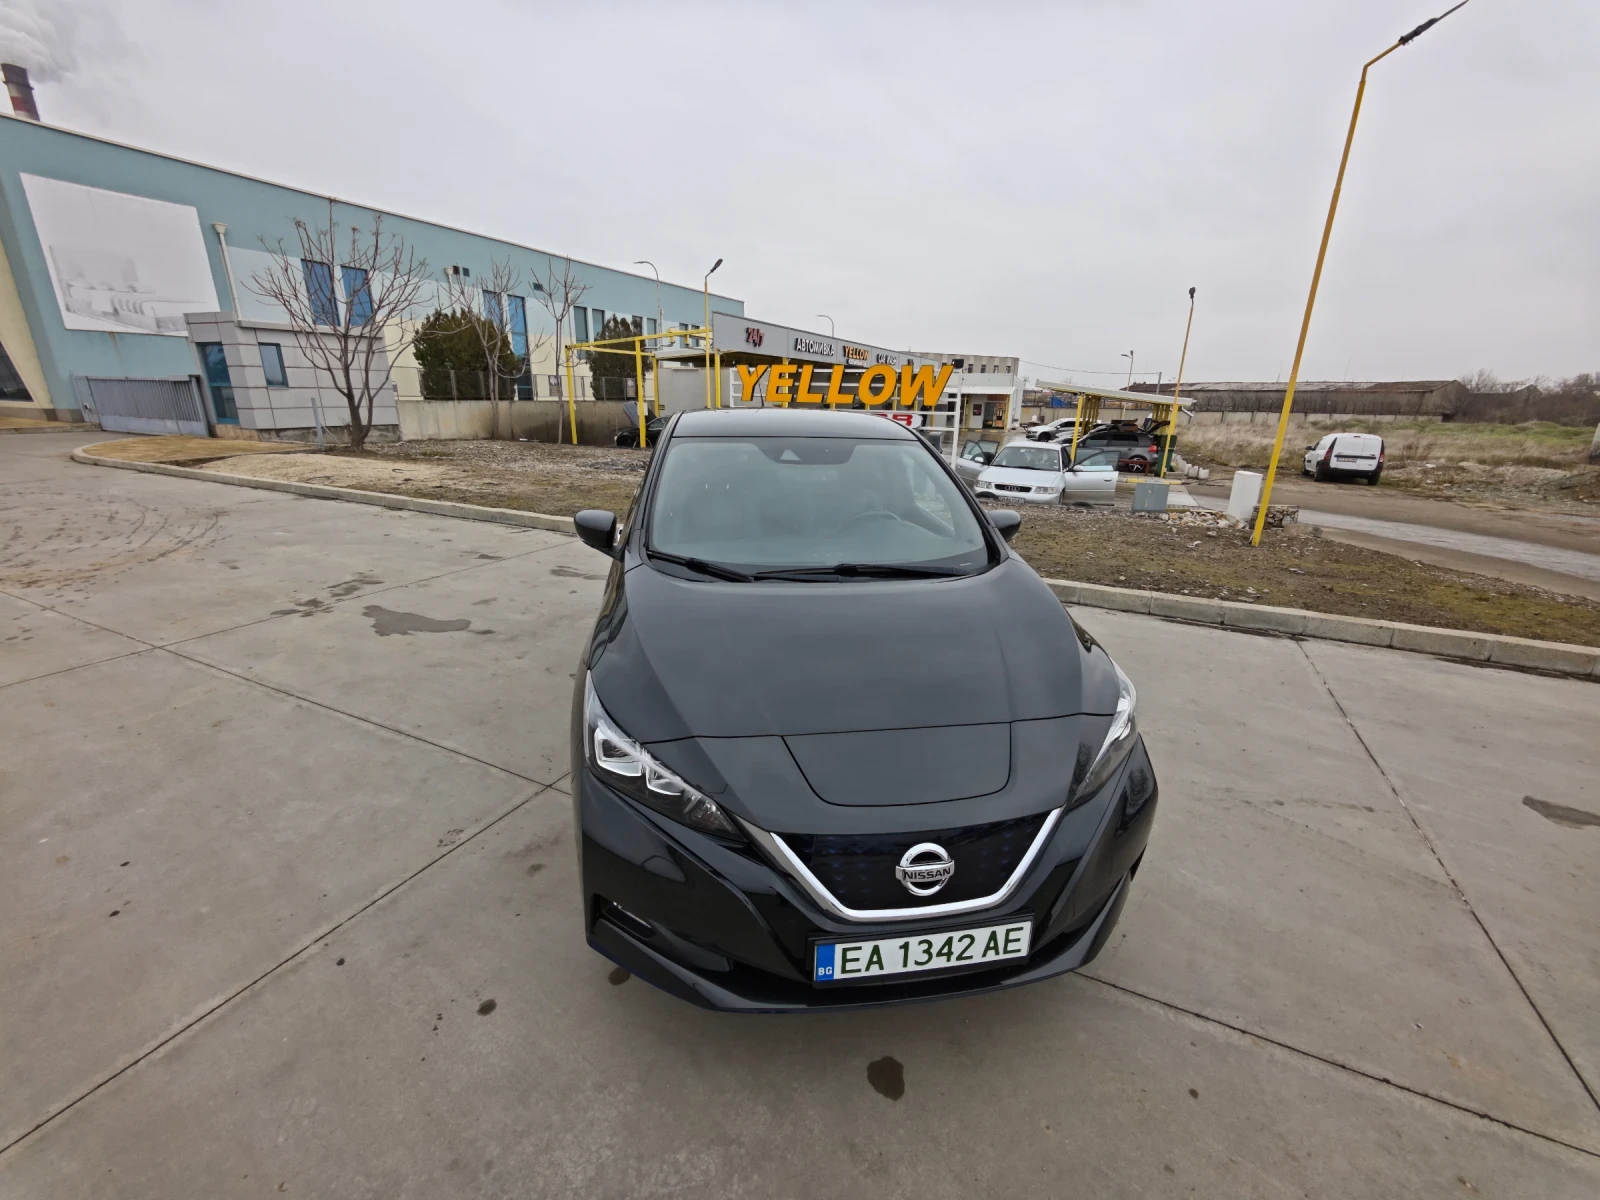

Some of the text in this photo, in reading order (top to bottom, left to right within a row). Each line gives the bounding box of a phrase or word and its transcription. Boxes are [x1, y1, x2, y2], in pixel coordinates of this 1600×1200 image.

[746, 326, 765, 348] 24/7
[795, 337, 835, 356] АВТОМИВКА
[844, 345, 869, 360] YELLOW
[736, 364, 955, 407] YELLOW
[903, 867, 951, 880] NISSAN
[840, 926, 1024, 975] EA 1342 AE
[817, 966, 833, 976] BG
